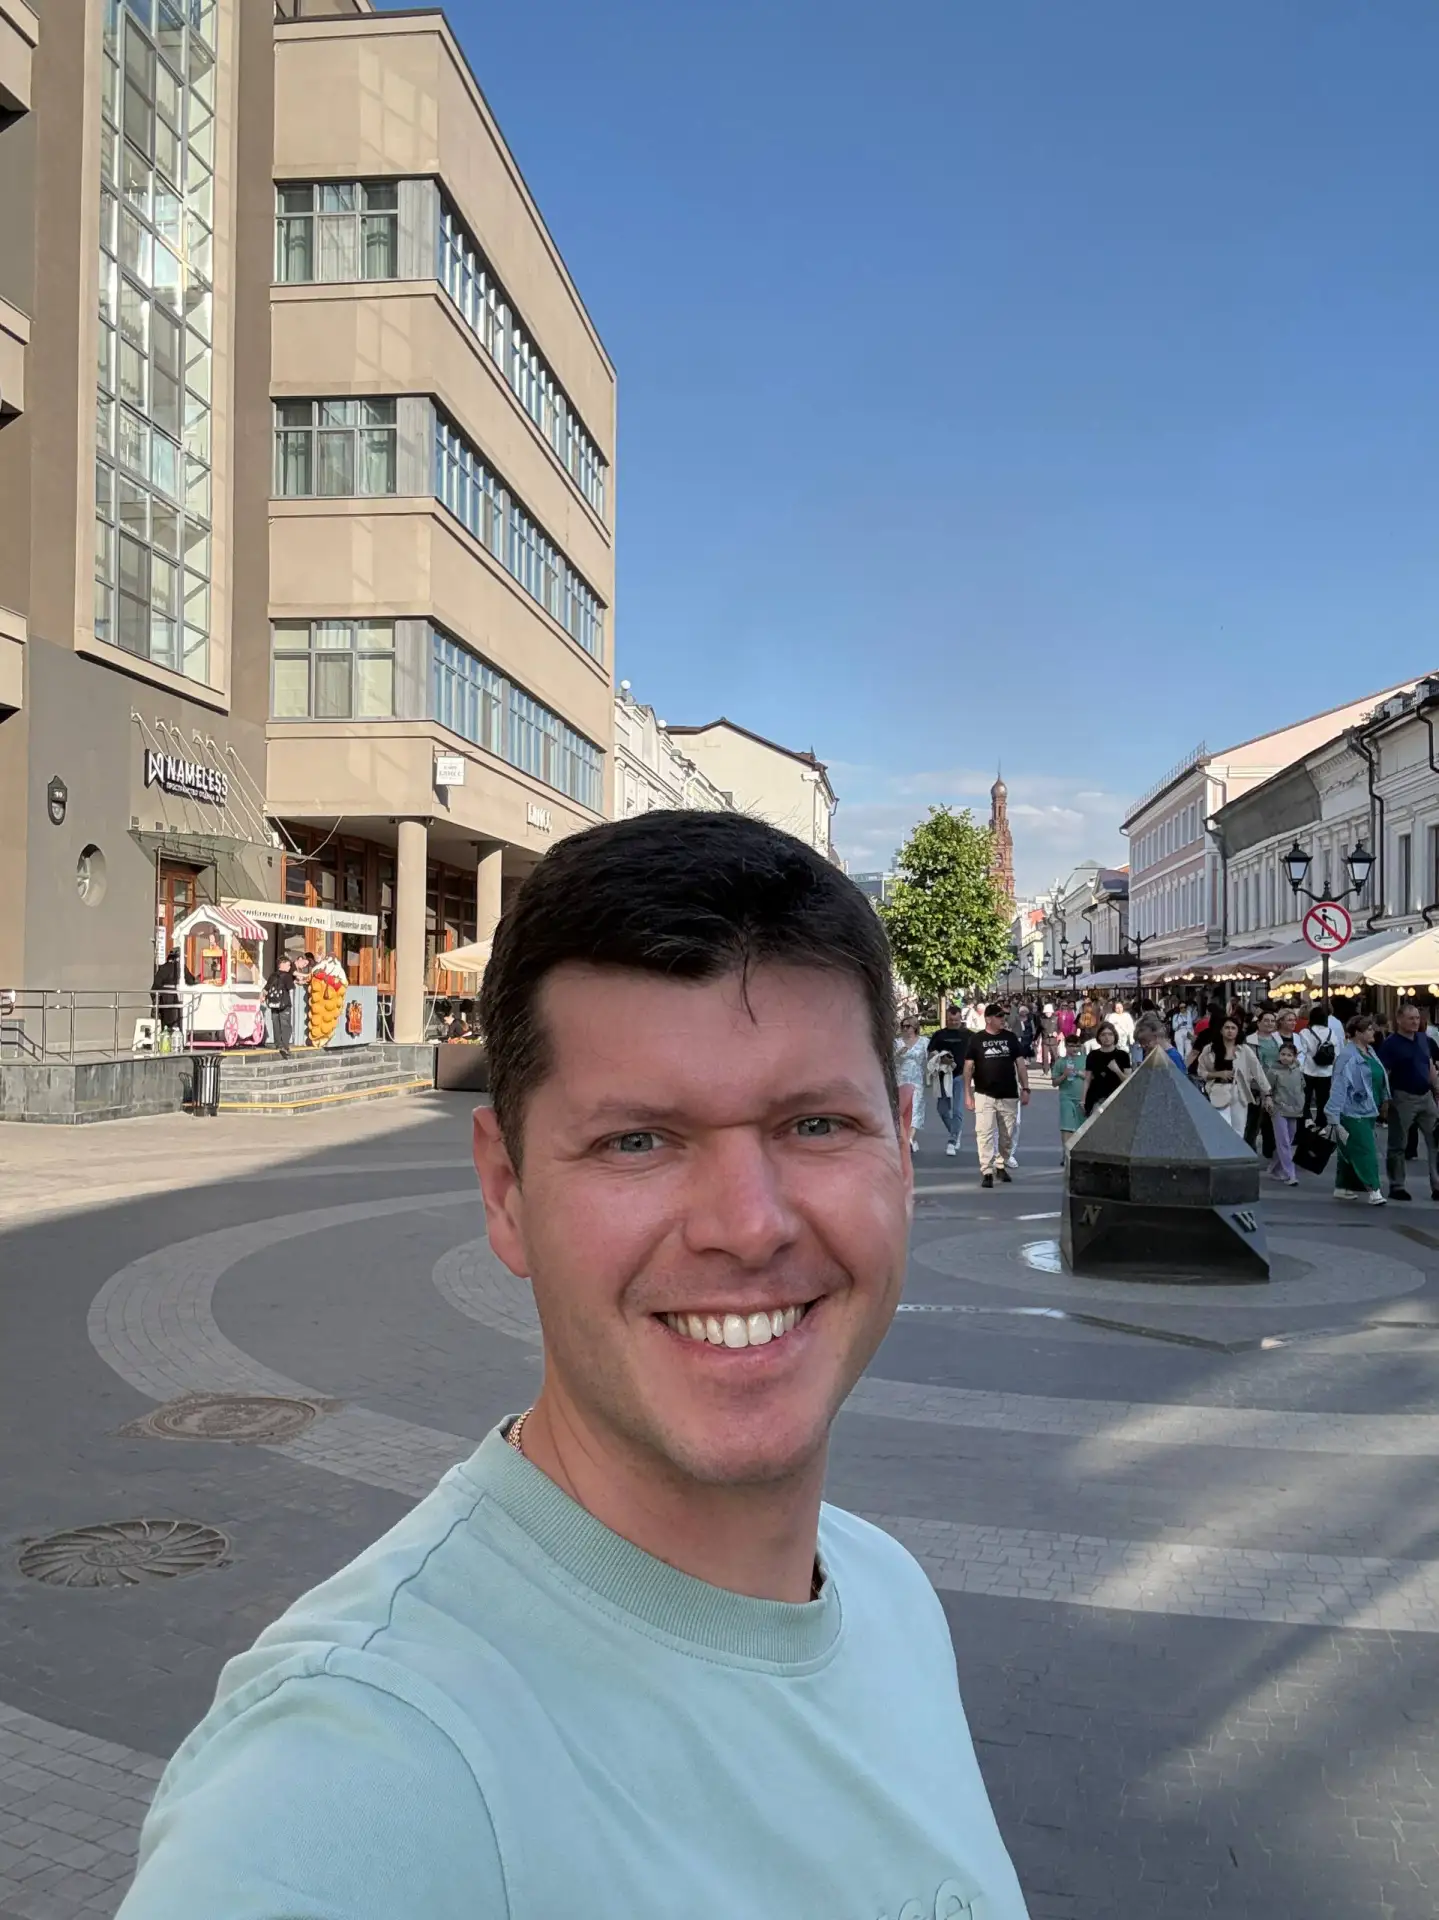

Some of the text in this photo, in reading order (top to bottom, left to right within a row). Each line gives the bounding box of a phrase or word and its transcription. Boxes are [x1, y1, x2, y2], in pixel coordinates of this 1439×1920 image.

[167, 755, 228, 796] NAMELESS
[982, 1040, 1008, 1048] EGYPT
[1080, 1204, 1102, 1226] N
[1233, 1210, 1258, 1233] W
